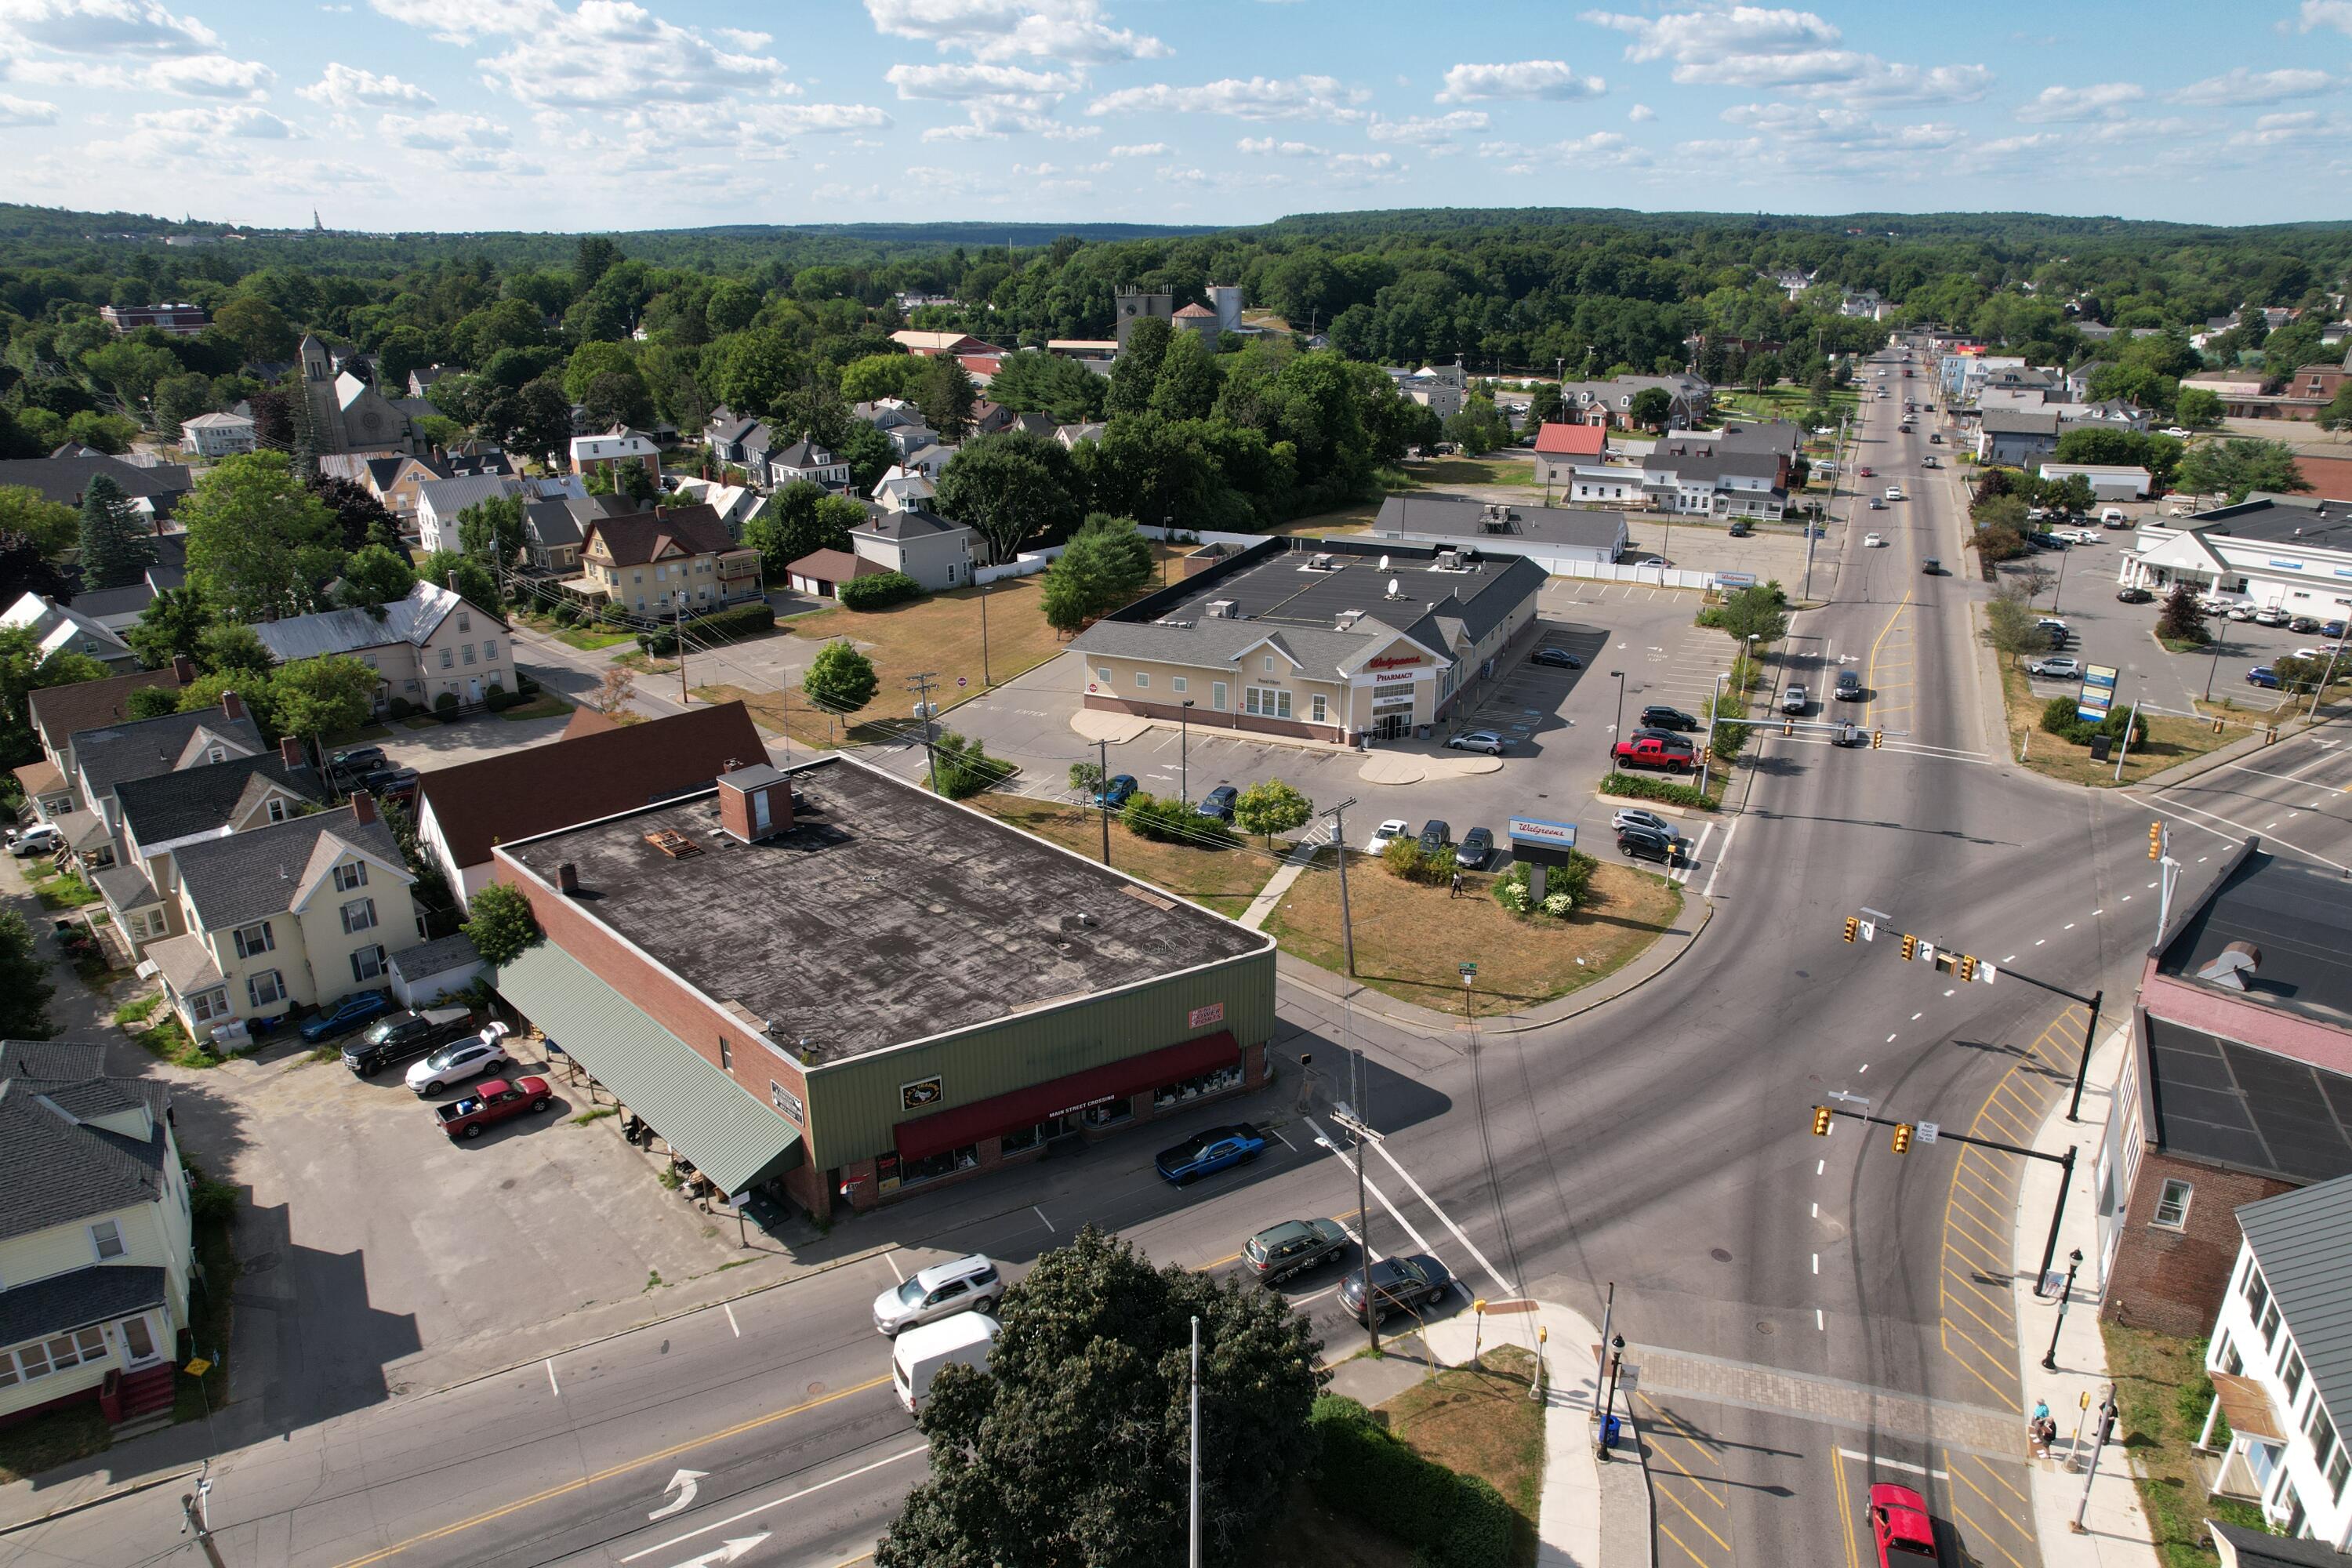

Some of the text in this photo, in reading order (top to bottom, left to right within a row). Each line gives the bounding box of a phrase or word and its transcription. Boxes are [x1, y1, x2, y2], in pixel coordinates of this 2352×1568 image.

[1370, 655, 1421, 669] Walgreens
[1377, 673, 1413, 681] PHARMACY
[1519, 823, 1564, 837] Walgreens
[1192, 1009, 1221, 1022] POWER
[1192, 1015, 1221, 1026] SPORTS
[1065, 1103, 1086, 1113] STREET
[1087, 1094, 1115, 1106] CROSSING
